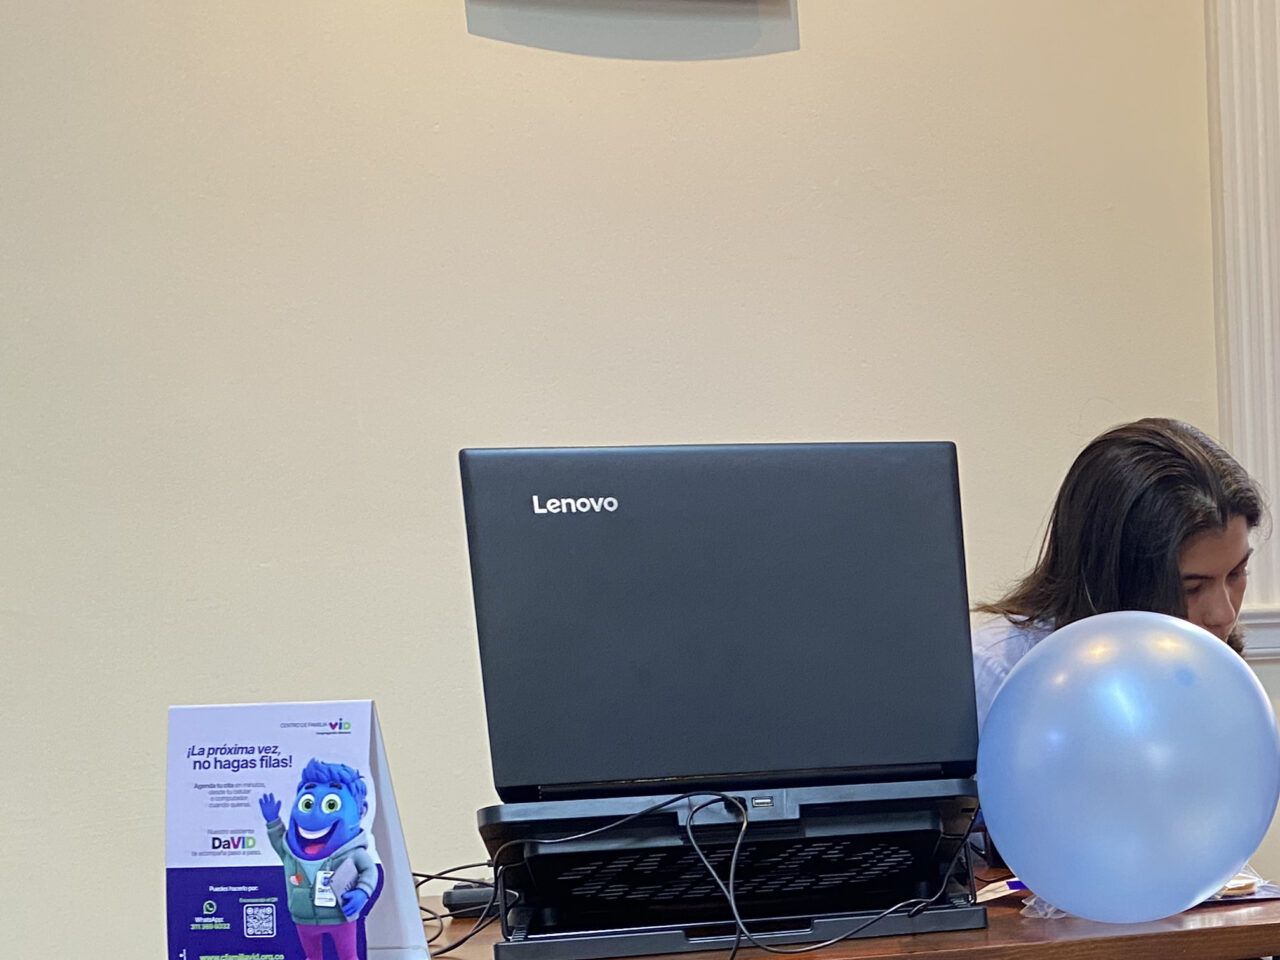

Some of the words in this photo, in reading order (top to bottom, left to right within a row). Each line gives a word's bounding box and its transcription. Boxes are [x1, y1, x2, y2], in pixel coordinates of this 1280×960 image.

[532, 495, 618, 514] Lenovo
[186, 745, 205, 759] ¡La
[206, 744, 255, 759] próxima
[257, 745, 281, 757] vez,
[192, 759, 211, 771] no
[213, 757, 257, 773] hagas
[259, 755, 293, 769] filas!
[211, 836, 256, 850] DaVID
